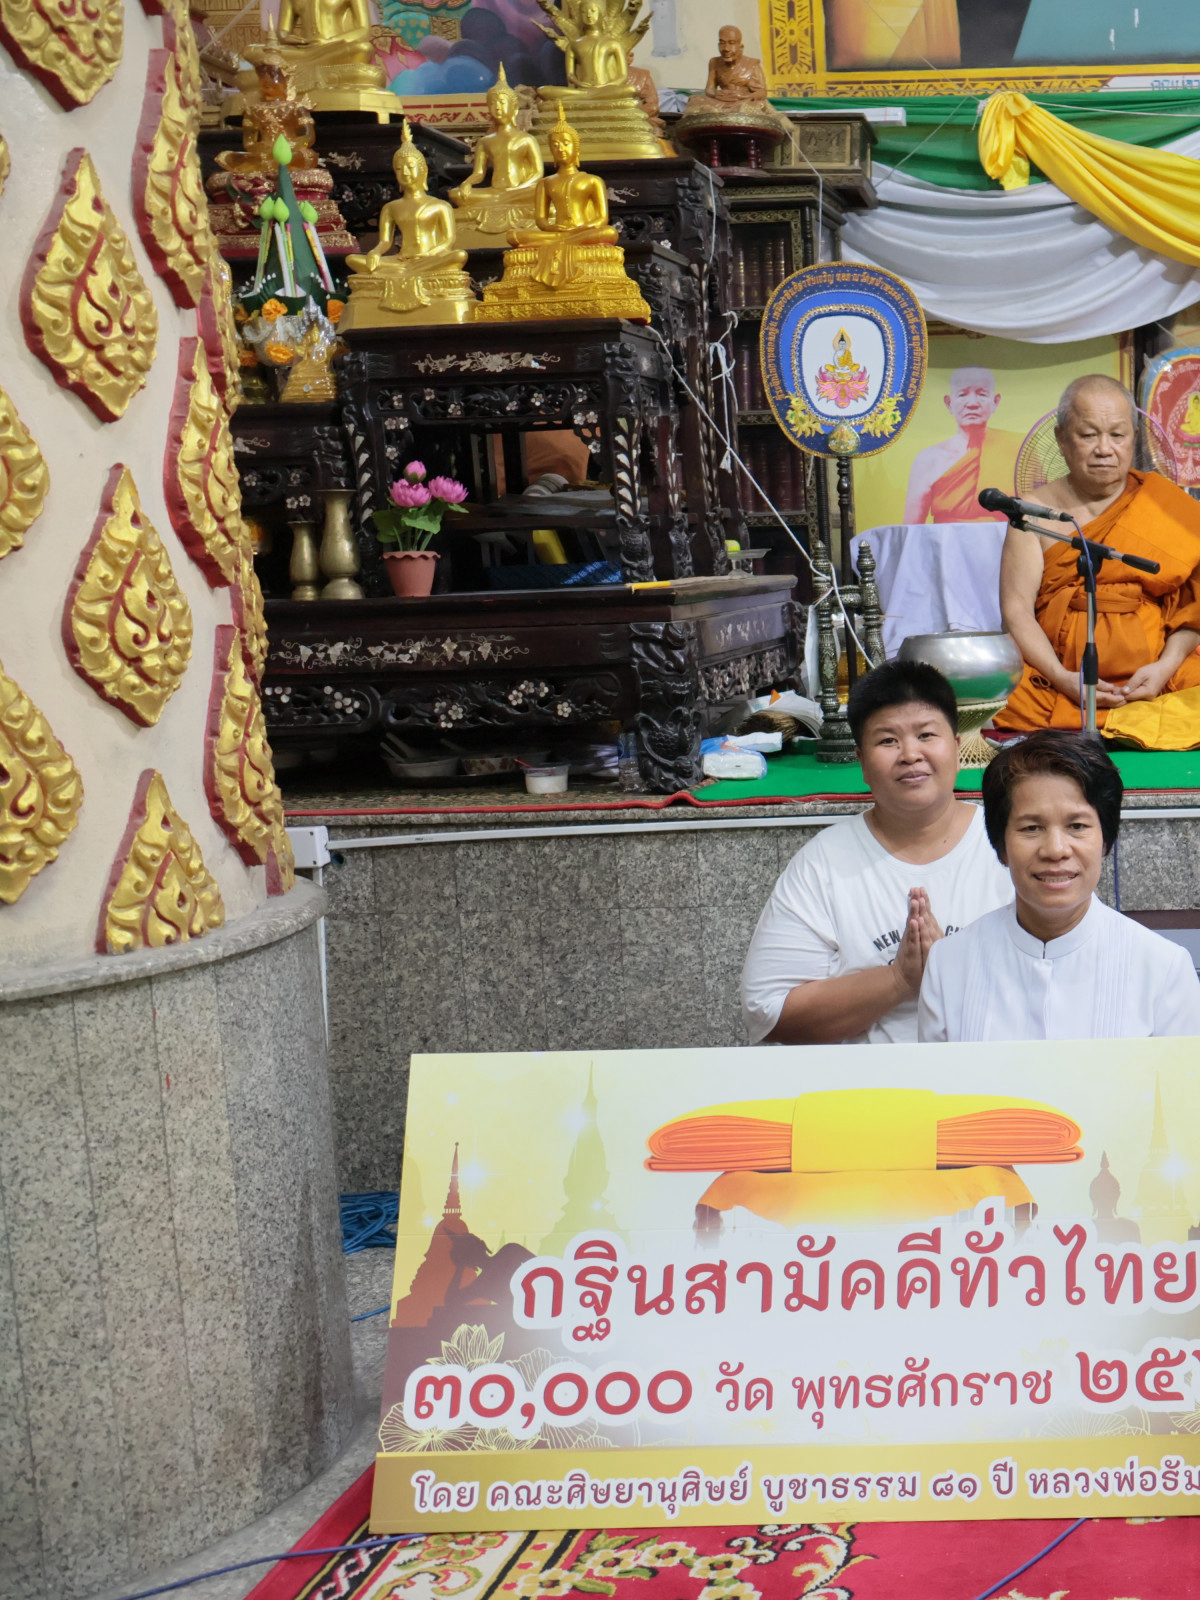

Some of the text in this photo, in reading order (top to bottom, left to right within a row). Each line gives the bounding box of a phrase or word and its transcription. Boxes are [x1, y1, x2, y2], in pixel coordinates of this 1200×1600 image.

[873, 929, 902, 951] NEW
[521, 1207, 1198, 1342] กฐินสามัคคีทั่วไทย
[414, 1370, 693, 1429] ๓๐,๐๐๐
[715, 1361, 774, 1412] วัด
[792, 1356, 1054, 1430] พุทธศักราช
[415, 1474, 476, 1508] โดย
[490, 1466, 749, 1519] คณะศิษยานุศิษย์
[763, 1476, 917, 1514] บูชาธรรม
[932, 1474, 978, 1498] ๘๑
[992, 1461, 1014, 1497] ปี
